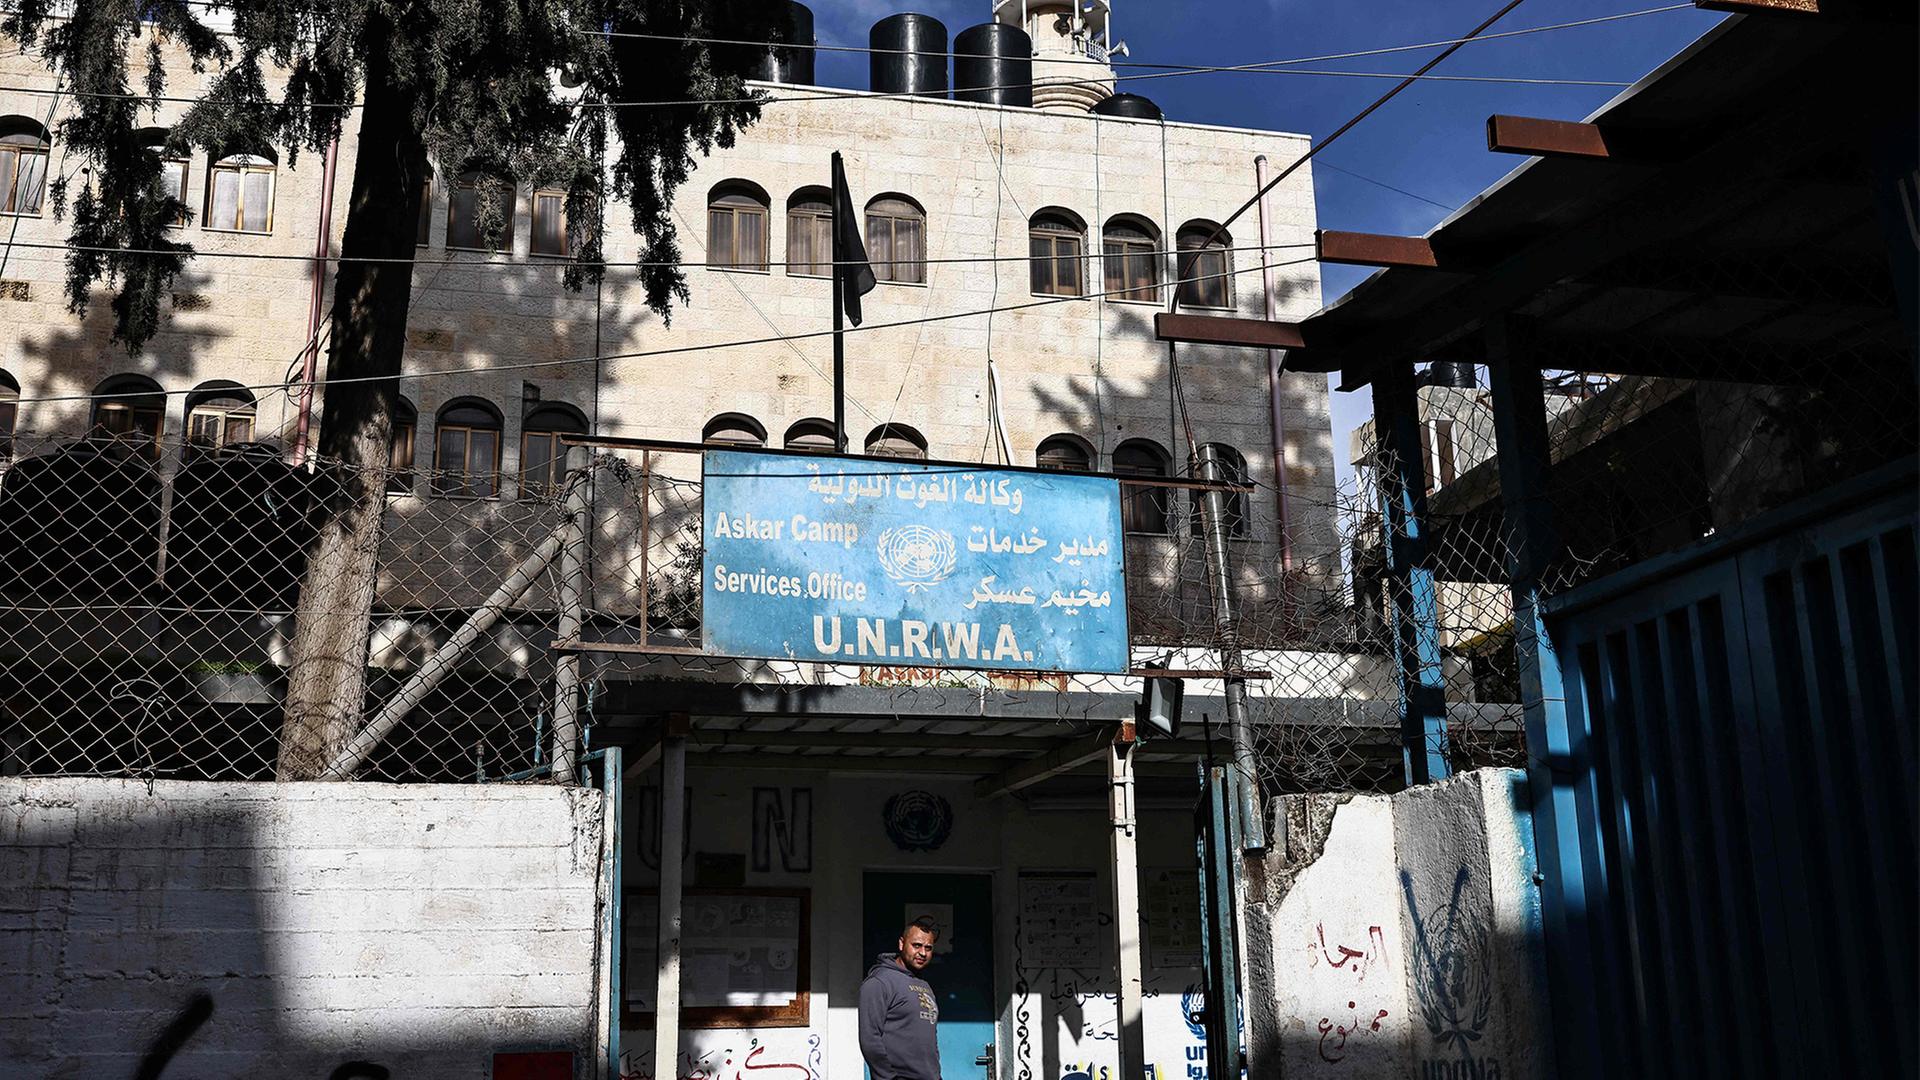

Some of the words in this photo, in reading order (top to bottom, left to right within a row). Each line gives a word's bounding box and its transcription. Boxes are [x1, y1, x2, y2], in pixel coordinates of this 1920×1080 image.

[807, 463, 890, 505] الدولية
[895, 470, 957, 508] الغوث
[963, 474, 1023, 514] وكالة
[715, 512, 786, 541] Askar
[791, 516, 858, 548] Camp
[967, 526, 1048, 555] خدمات
[1053, 536, 1109, 566] مدير
[714, 565, 801, 597] Services
[808, 572, 866, 601] Office
[963, 576, 1036, 610] عسكر
[1041, 580, 1111, 615] مخيم
[813, 615, 1033, 662] U.N.R.W.A.
